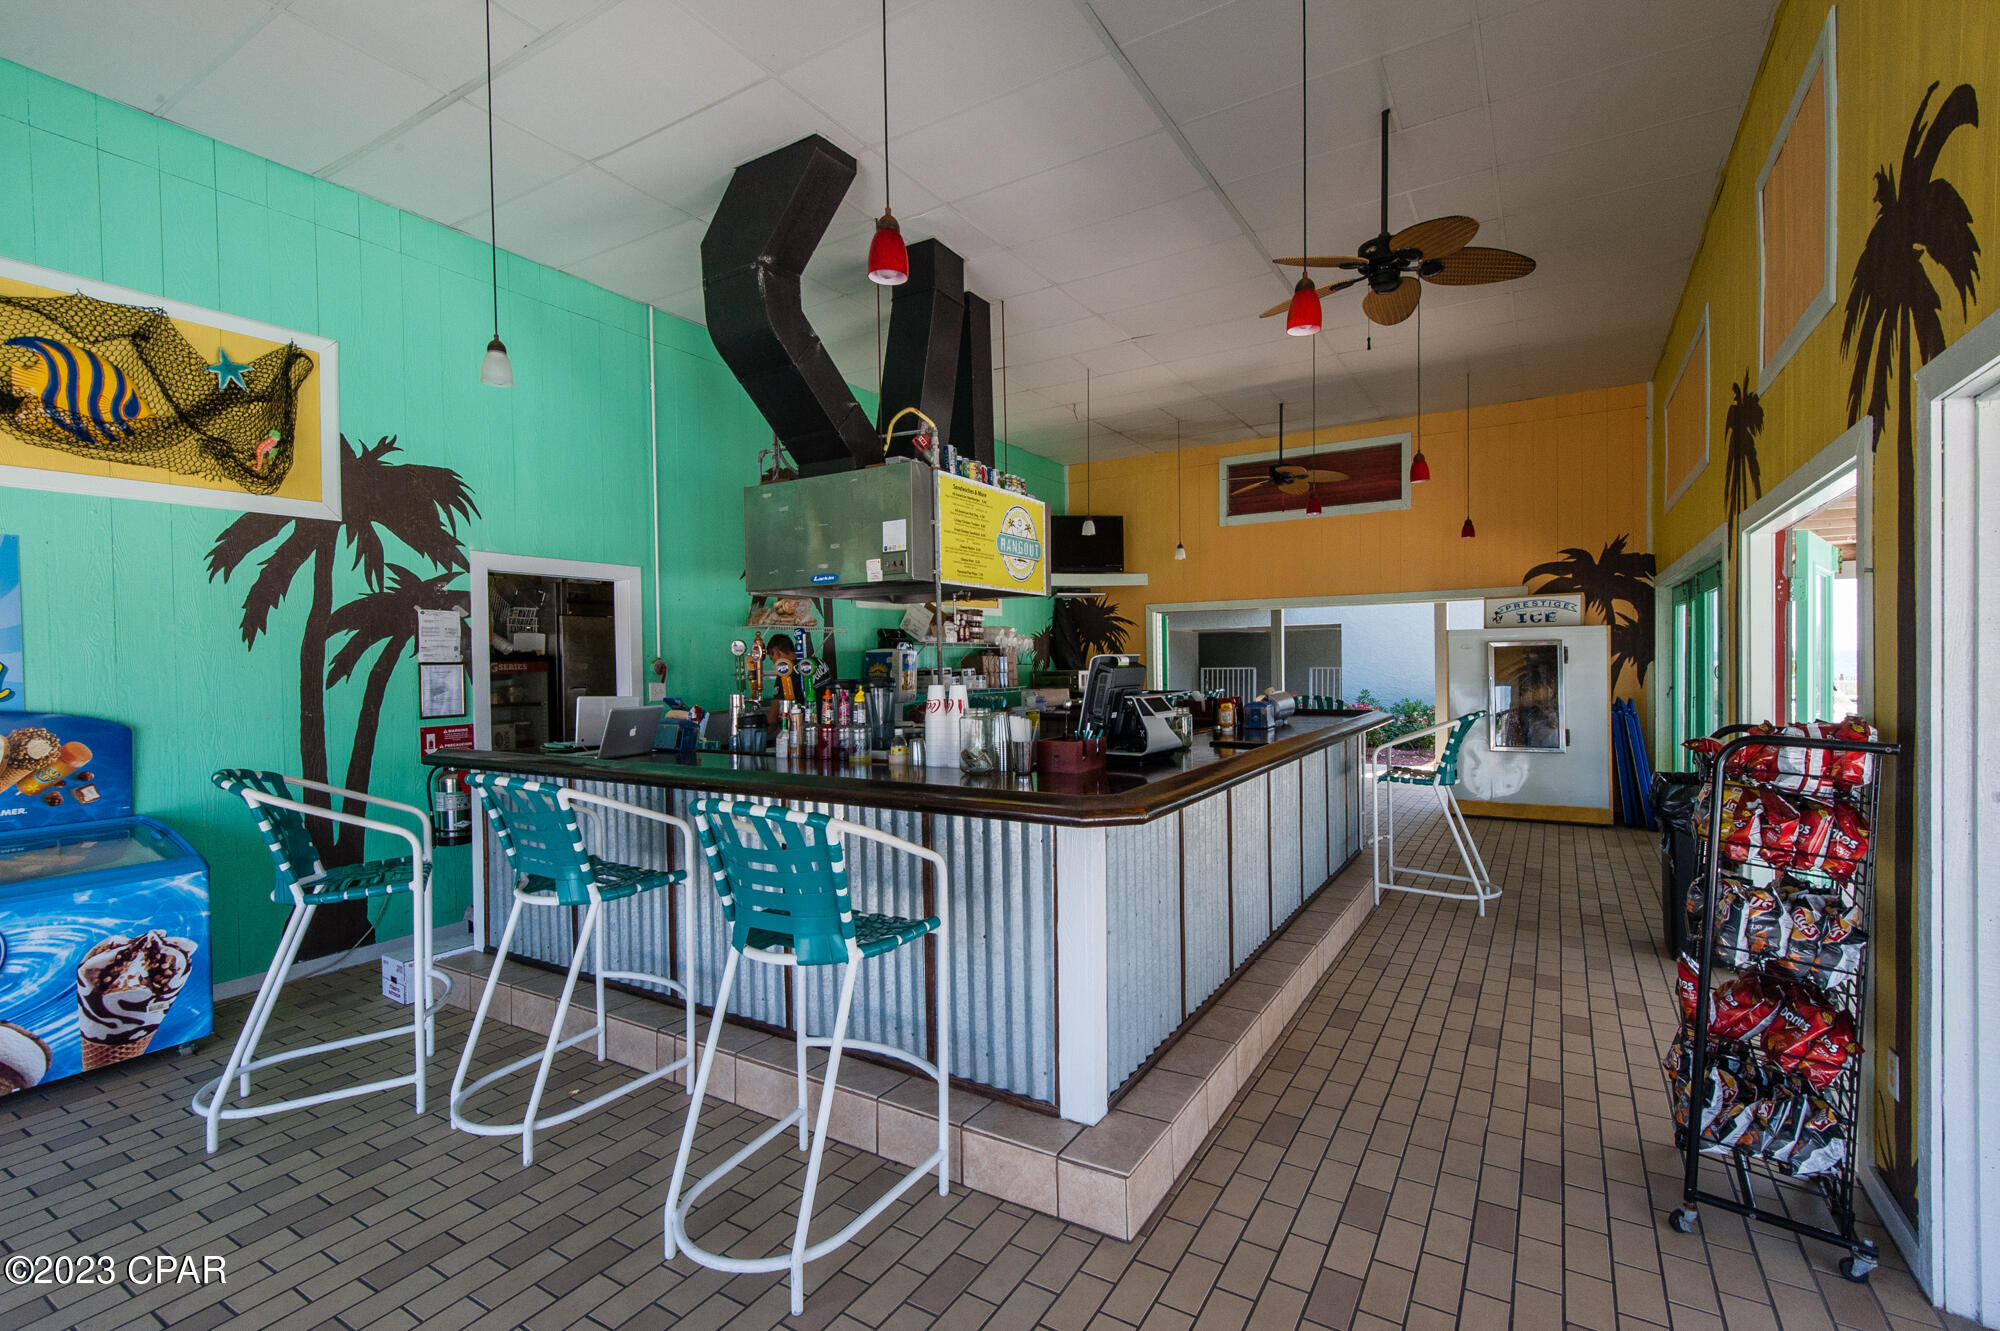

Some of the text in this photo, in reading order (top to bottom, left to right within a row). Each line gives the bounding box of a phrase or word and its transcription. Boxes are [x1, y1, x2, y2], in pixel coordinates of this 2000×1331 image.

[1000, 537, 1039, 557] HANGOUT
[1505, 600, 1570, 611] PRESTIGE
[1516, 610, 1557, 623] ICE
[498, 663, 528, 671] SERIES
